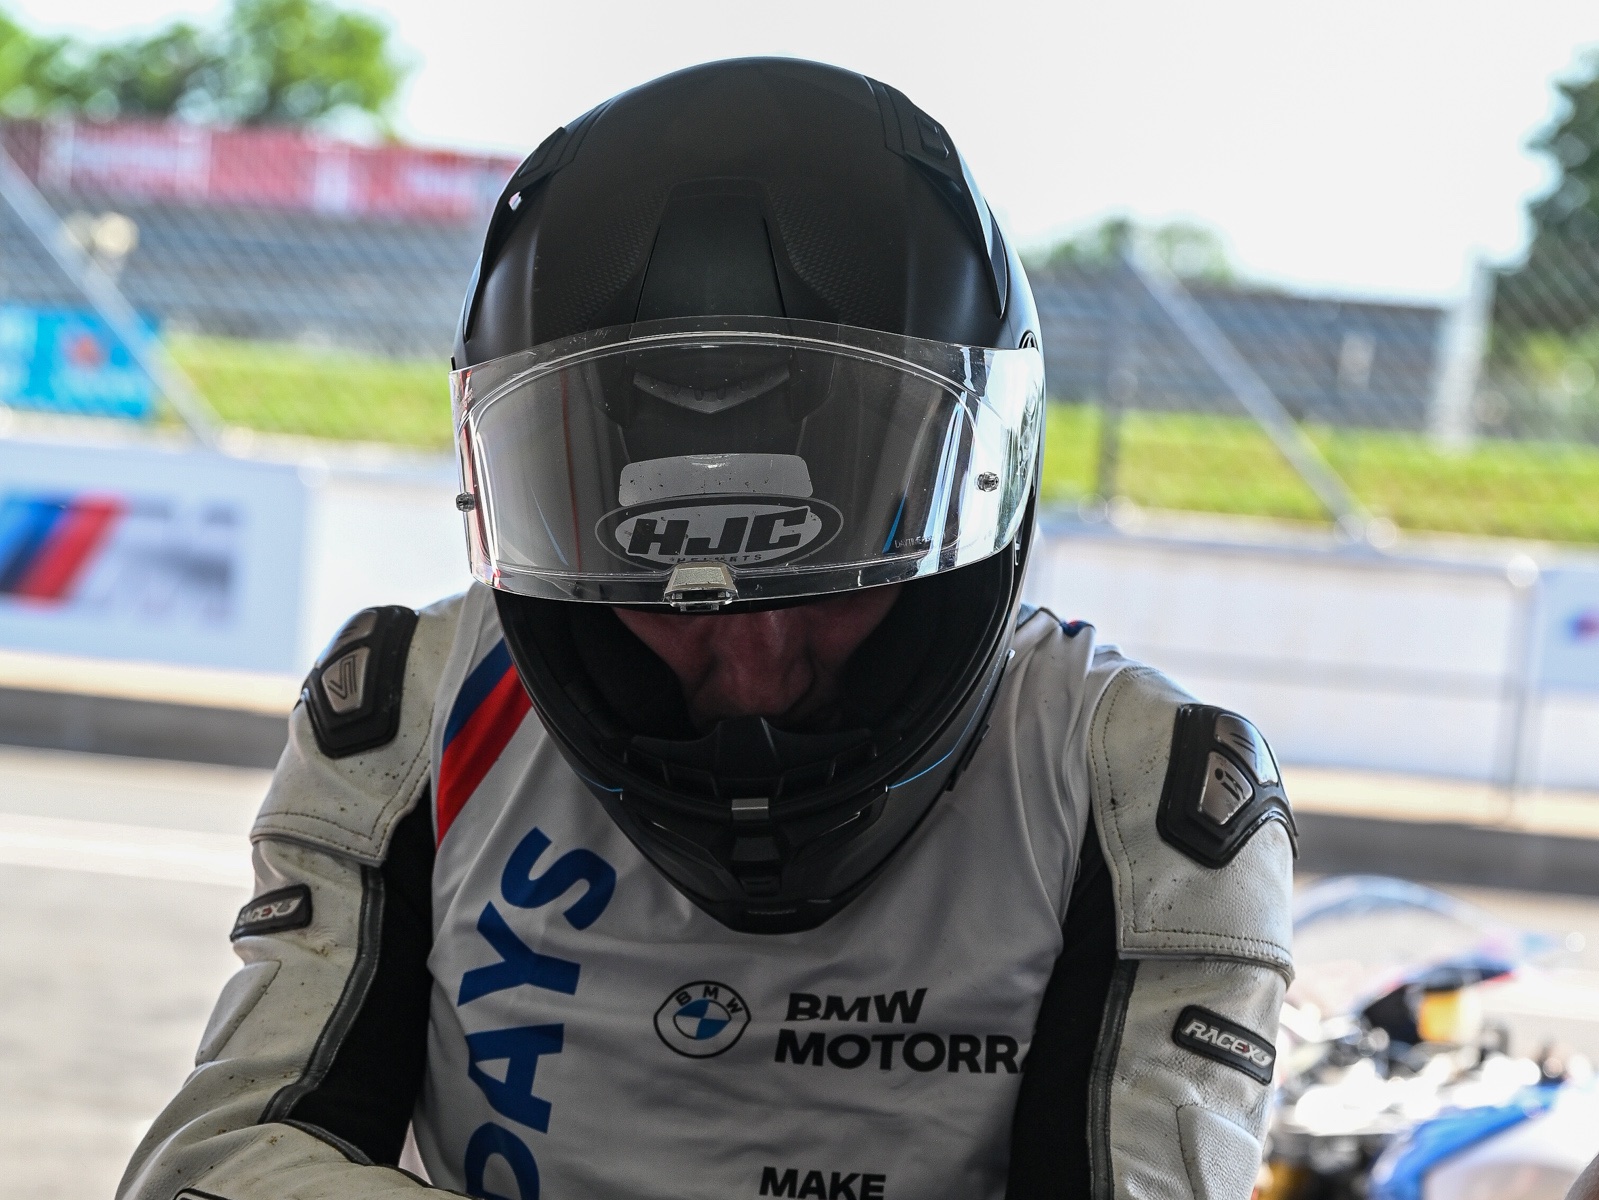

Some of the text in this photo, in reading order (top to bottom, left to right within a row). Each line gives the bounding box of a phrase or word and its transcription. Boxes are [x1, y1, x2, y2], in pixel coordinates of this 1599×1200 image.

[627, 506, 812, 556] HJC
[675, 985, 743, 1014] BMW
[785, 987, 928, 1024] BMW
[774, 1028, 1025, 1074] MOTORR
